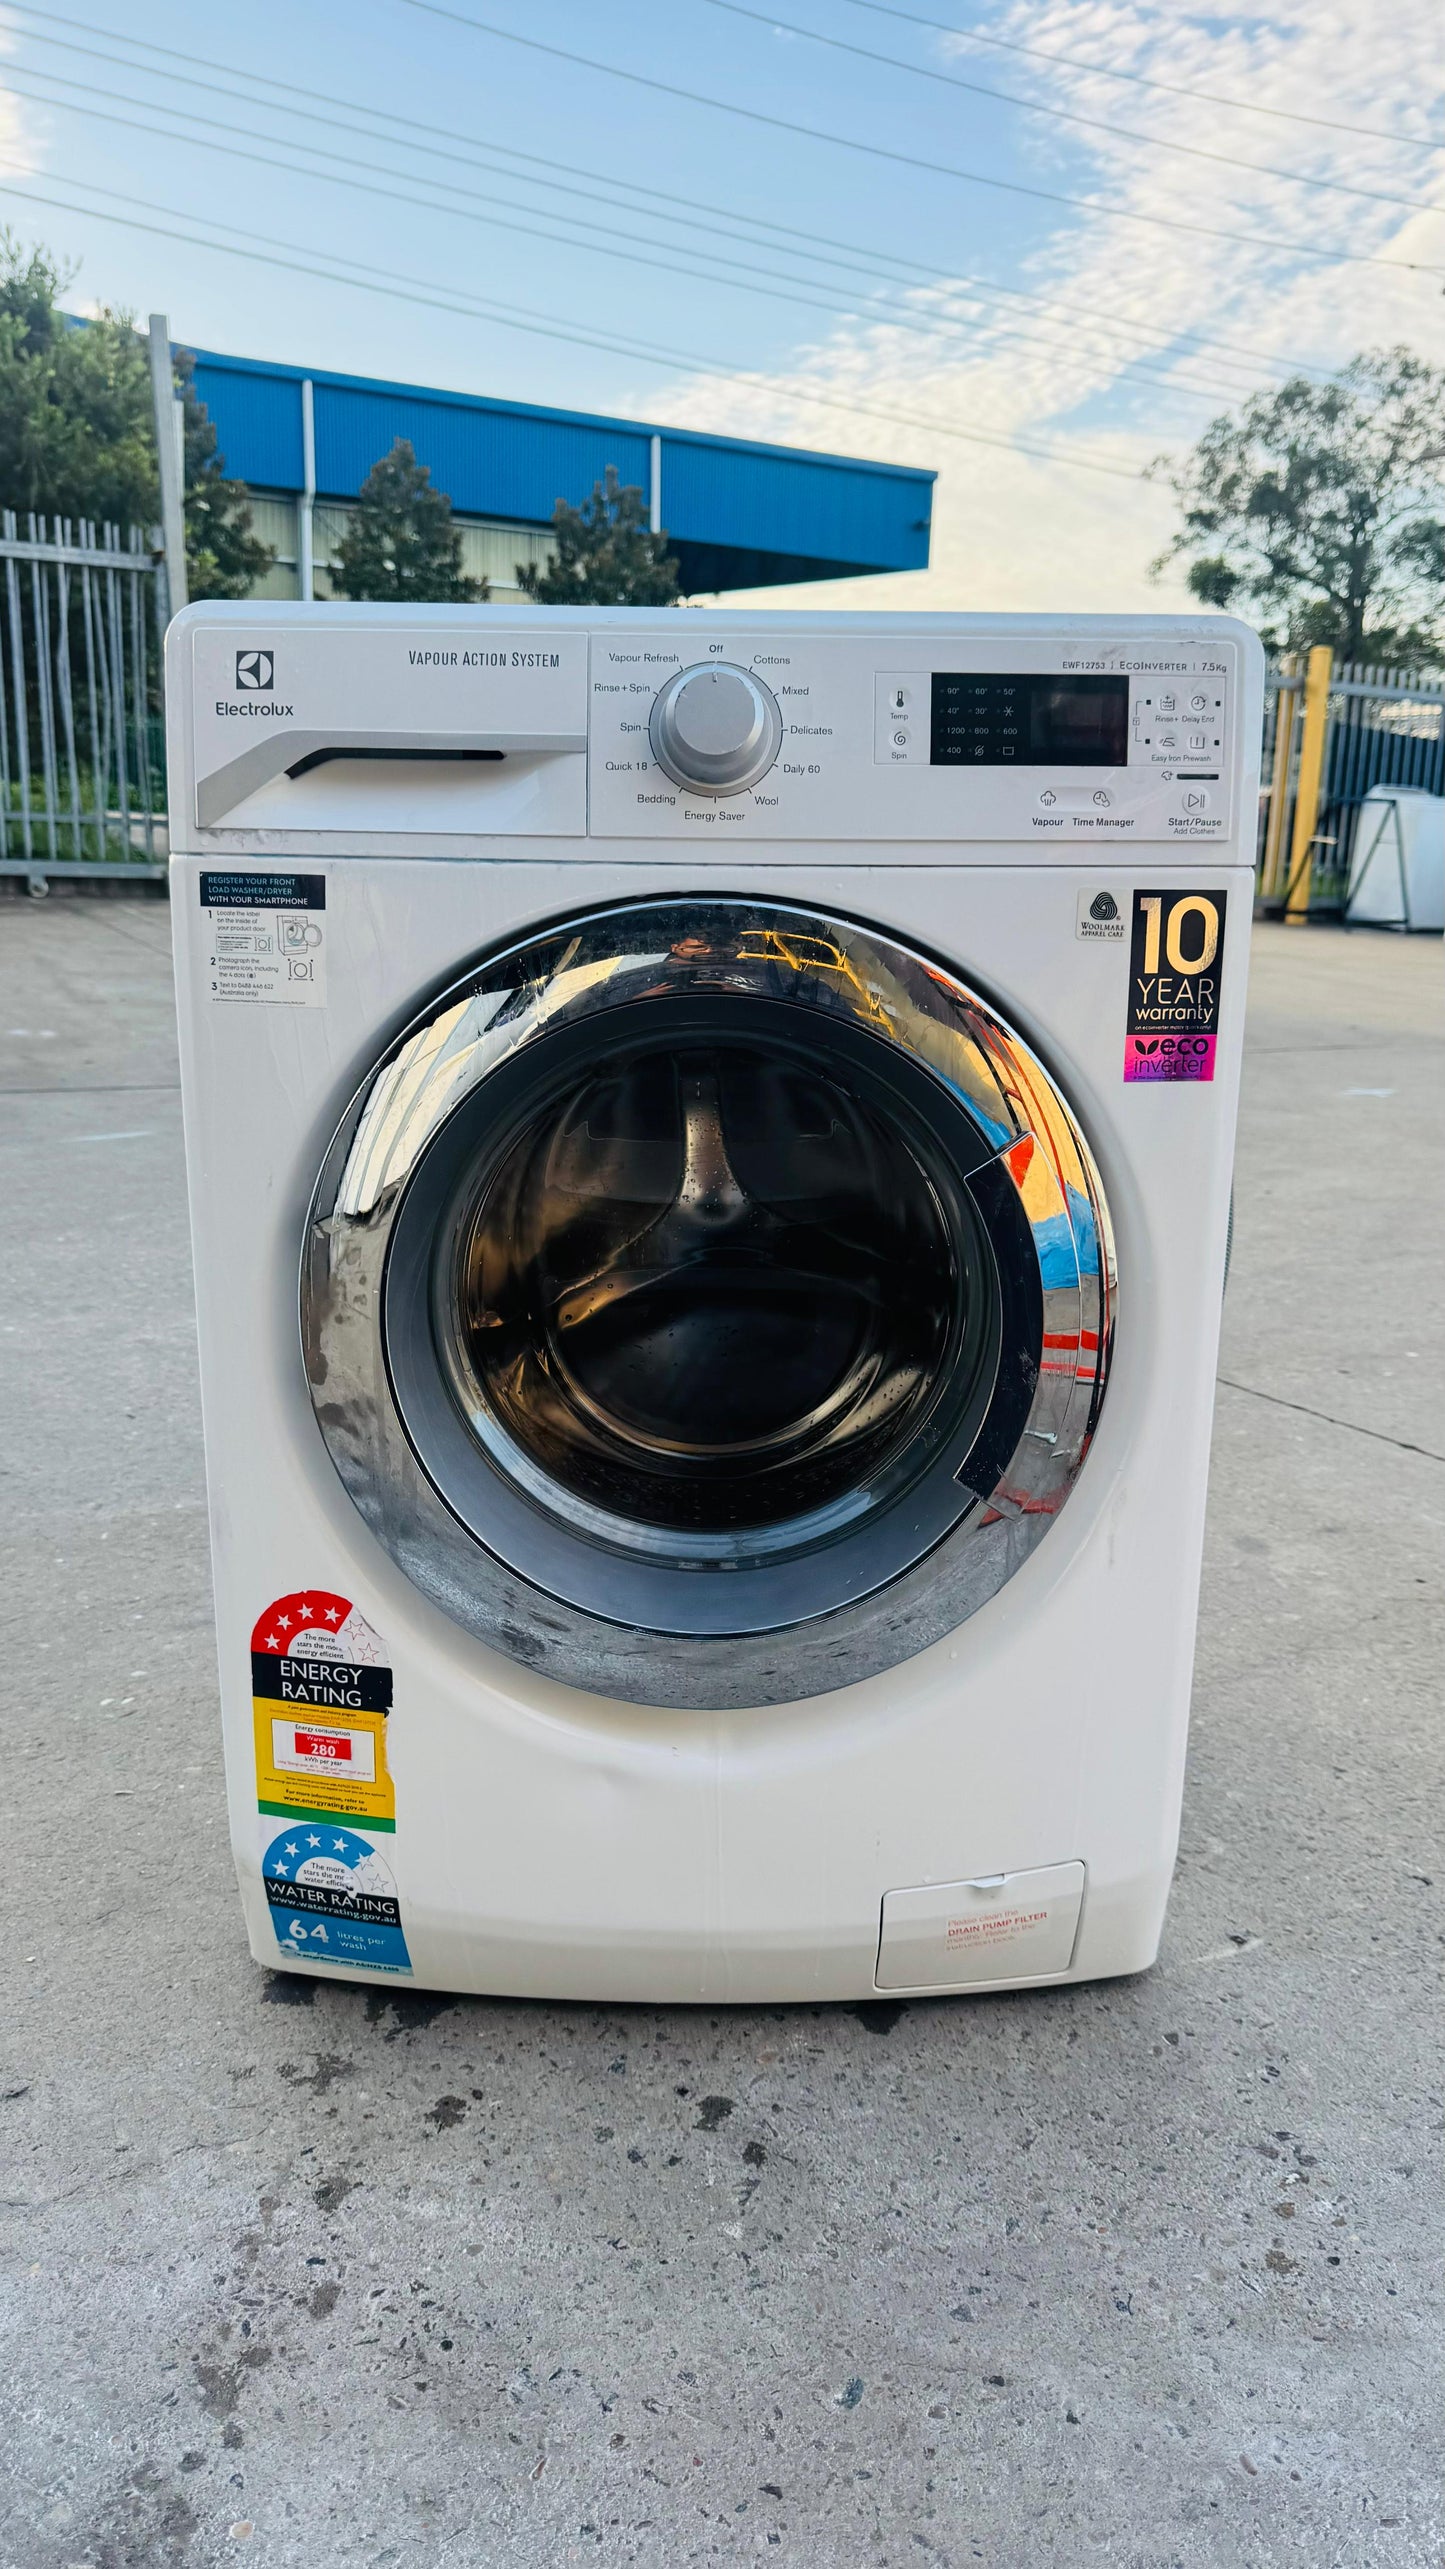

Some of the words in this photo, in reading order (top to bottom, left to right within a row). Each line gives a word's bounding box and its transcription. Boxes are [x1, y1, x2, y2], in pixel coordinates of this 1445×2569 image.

[709, 645, 723, 653] Off
[409, 651, 458, 665] VAPOUR
[463, 651, 506, 666] ACTION
[512, 652, 560, 668] SYSTEM
[609, 653, 641, 664] Vapour
[644, 653, 679, 663] Refresh
[754, 655, 791, 665] Cottons
[1063, 662, 1106, 670] EWF12753
[1120, 662, 1187, 671] ECOINVERTER
[1202, 663, 1227, 673] 7.5Kg
[782, 687, 809, 696] Mixed
[216, 702, 294, 716] Electrolux
[891, 713, 909, 721] Temp
[1182, 716, 1201, 724] Delay
[620, 723, 642, 734] Spin
[790, 726, 833, 735] Delicates
[947, 727, 965, 735] 1200
[891, 752, 907, 760] Spin
[1152, 755, 1168, 763] Easy
[606, 762, 633, 771] Quick
[636, 762, 648, 771] 18
[784, 765, 805, 775] Daily
[808, 766, 821, 774] 60
[637, 795, 676, 805] Bedding
[755, 797, 779, 806] Wool
[685, 811, 716, 822] Energy
[719, 812, 745, 821] Saver
[1032, 818, 1064, 827] Vapour
[1072, 818, 1094, 826] Time
[1096, 818, 1135, 827] Manager
[1168, 818, 1222, 827] Start/Pause
[232, 887, 293, 895] WASHER/DRYER
[231, 896, 253, 904] YOUR
[255, 897, 308, 905] SMARTPHONE
[1081, 922, 1125, 931] WOOLMARK
[1140, 896, 1219, 975] 10
[211, 957, 216, 966] 2
[212, 982, 218, 991] 3
[1137, 978, 1214, 1005] YEAR
[1136, 1005, 1214, 1024] warranty
[1160, 1038, 1209, 1055] eco
[1134, 1055, 1207, 1073] inverter
[297, 1649, 319, 1657] energy
[320, 1651, 345, 1660] efficient
[280, 1661, 363, 1686] ENERGY
[282, 1681, 362, 1707] RATING
[295, 1724, 314, 1733] Energy
[315, 1726, 351, 1737] consumption
[311, 1743, 336, 1757] 280
[283, 1795, 368, 1812] www.energyrating.gov.au
[312, 1862, 325, 1871] The
[327, 1866, 345, 1874] more
[268, 1881, 327, 1904] WATER
[331, 1893, 396, 1914] RATING
[271, 1896, 397, 1924] www.waterrating.gov.au
[948, 1918, 977, 1927] Please
[979, 1913, 1002, 1923] clean
[1004, 1910, 1019, 1918] the
[948, 1926, 980, 1937] DRAIN
[983, 1919, 1013, 1931] PUMP
[1015, 1912, 1048, 1925] FILTER
[289, 1919, 330, 1944] 64
[337, 1930, 364, 1942] litres
[368, 1936, 386, 1946] per
[340, 1940, 367, 1951] wash
